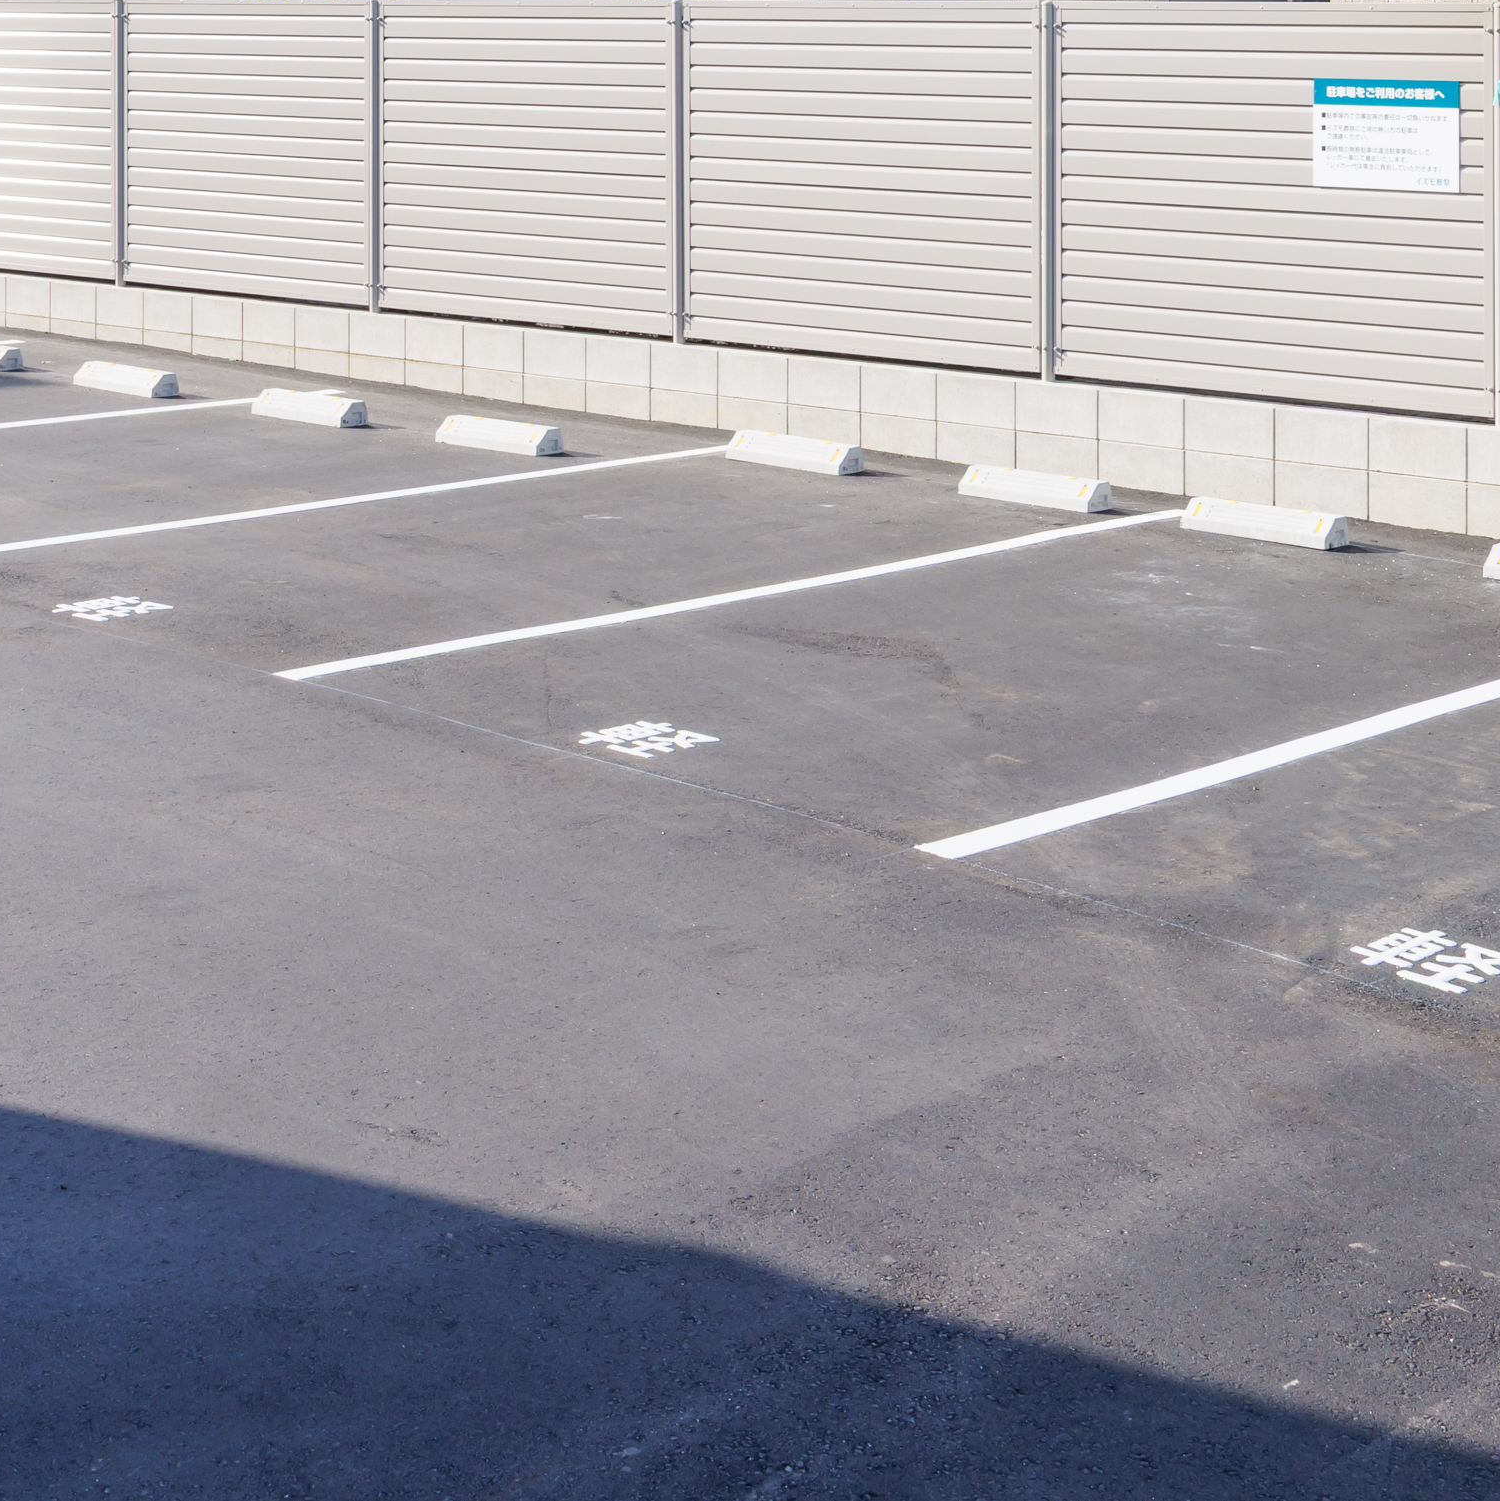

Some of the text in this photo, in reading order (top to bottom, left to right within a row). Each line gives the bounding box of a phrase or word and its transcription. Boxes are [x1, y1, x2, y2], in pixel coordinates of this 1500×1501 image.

[1326, 86, 1445, 100] 駐車場をご利用のお客様へ
[578, 720, 720, 758] 軽
